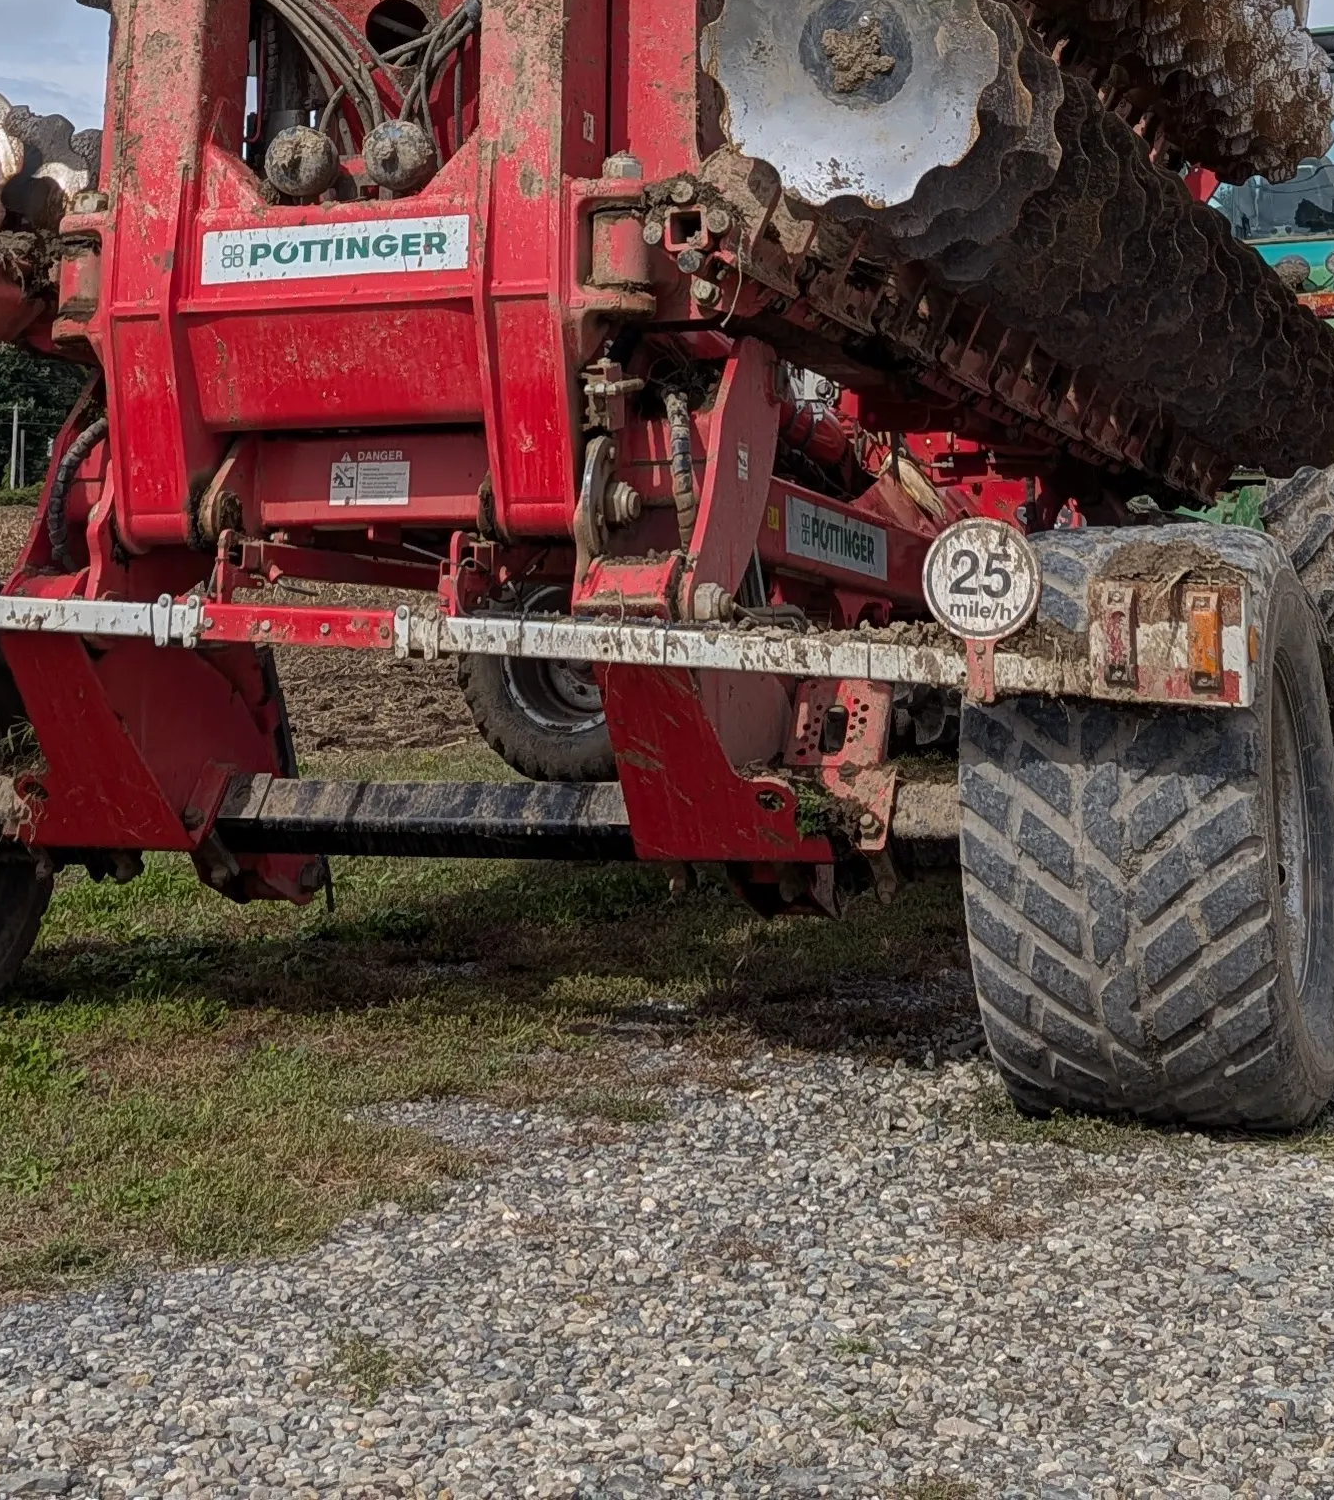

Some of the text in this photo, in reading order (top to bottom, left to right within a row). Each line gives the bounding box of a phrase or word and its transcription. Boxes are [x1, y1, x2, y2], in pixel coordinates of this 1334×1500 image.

[357, 450, 403, 461] DANGER
[949, 549, 1012, 598] 25
[949, 601, 1012, 621] mile/h
